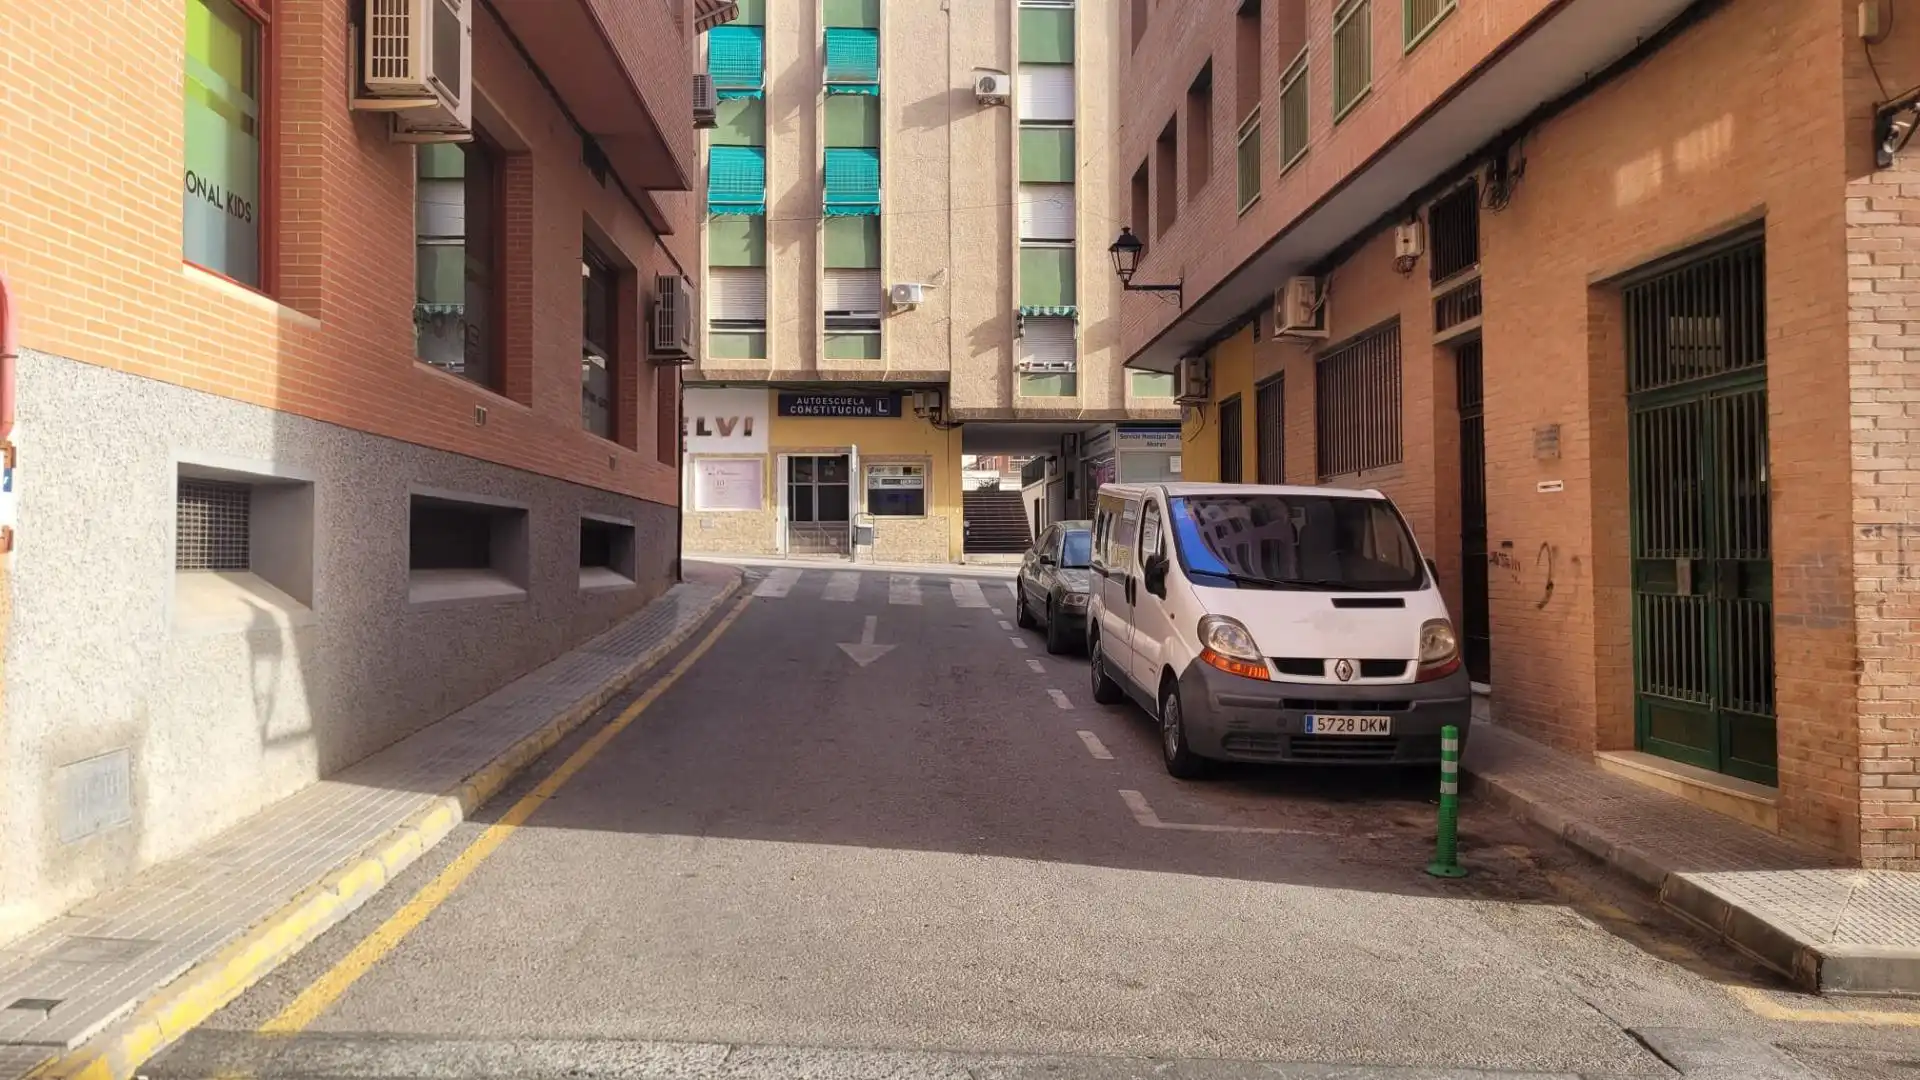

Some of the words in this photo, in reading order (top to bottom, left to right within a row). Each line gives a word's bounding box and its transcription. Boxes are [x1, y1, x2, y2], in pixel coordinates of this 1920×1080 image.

[226, 191, 252, 224] KIDS
[796, 397, 865, 405] AUTOESCUELA
[879, 400, 888, 413] L
[790, 405, 872, 415] CONSTITUCION
[1317, 717, 1355, 732] 5728
[1360, 718, 1388, 733] DKM
